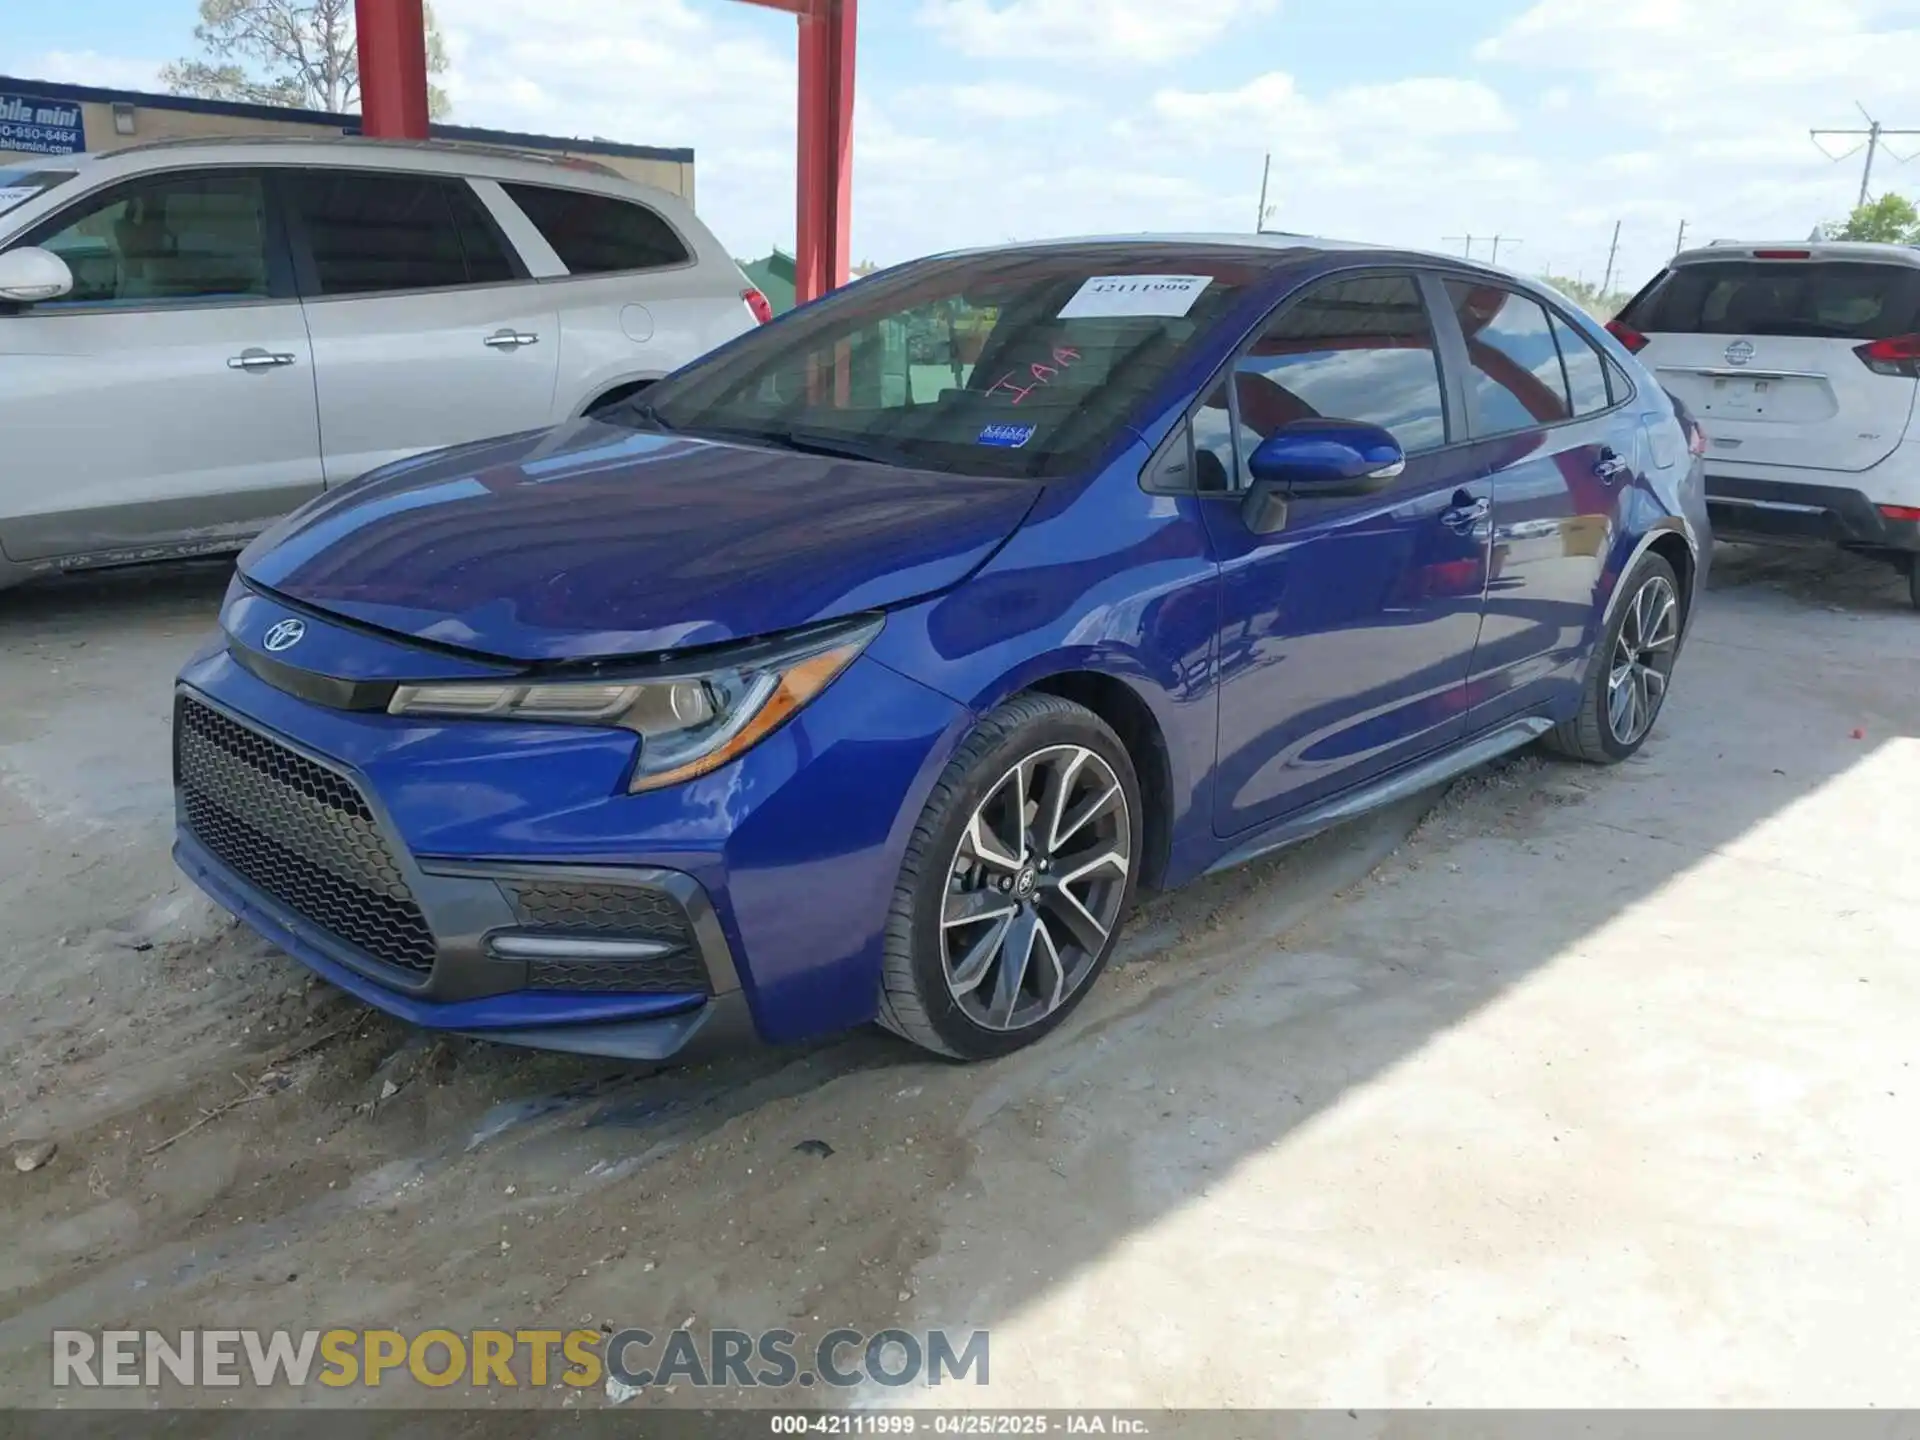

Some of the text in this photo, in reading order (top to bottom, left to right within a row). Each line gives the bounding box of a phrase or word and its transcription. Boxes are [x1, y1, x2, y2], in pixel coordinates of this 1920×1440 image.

[36, 106, 80, 127] mini
[0, 125, 77, 142] 0-950-6464
[984, 346, 1082, 405] IAA
